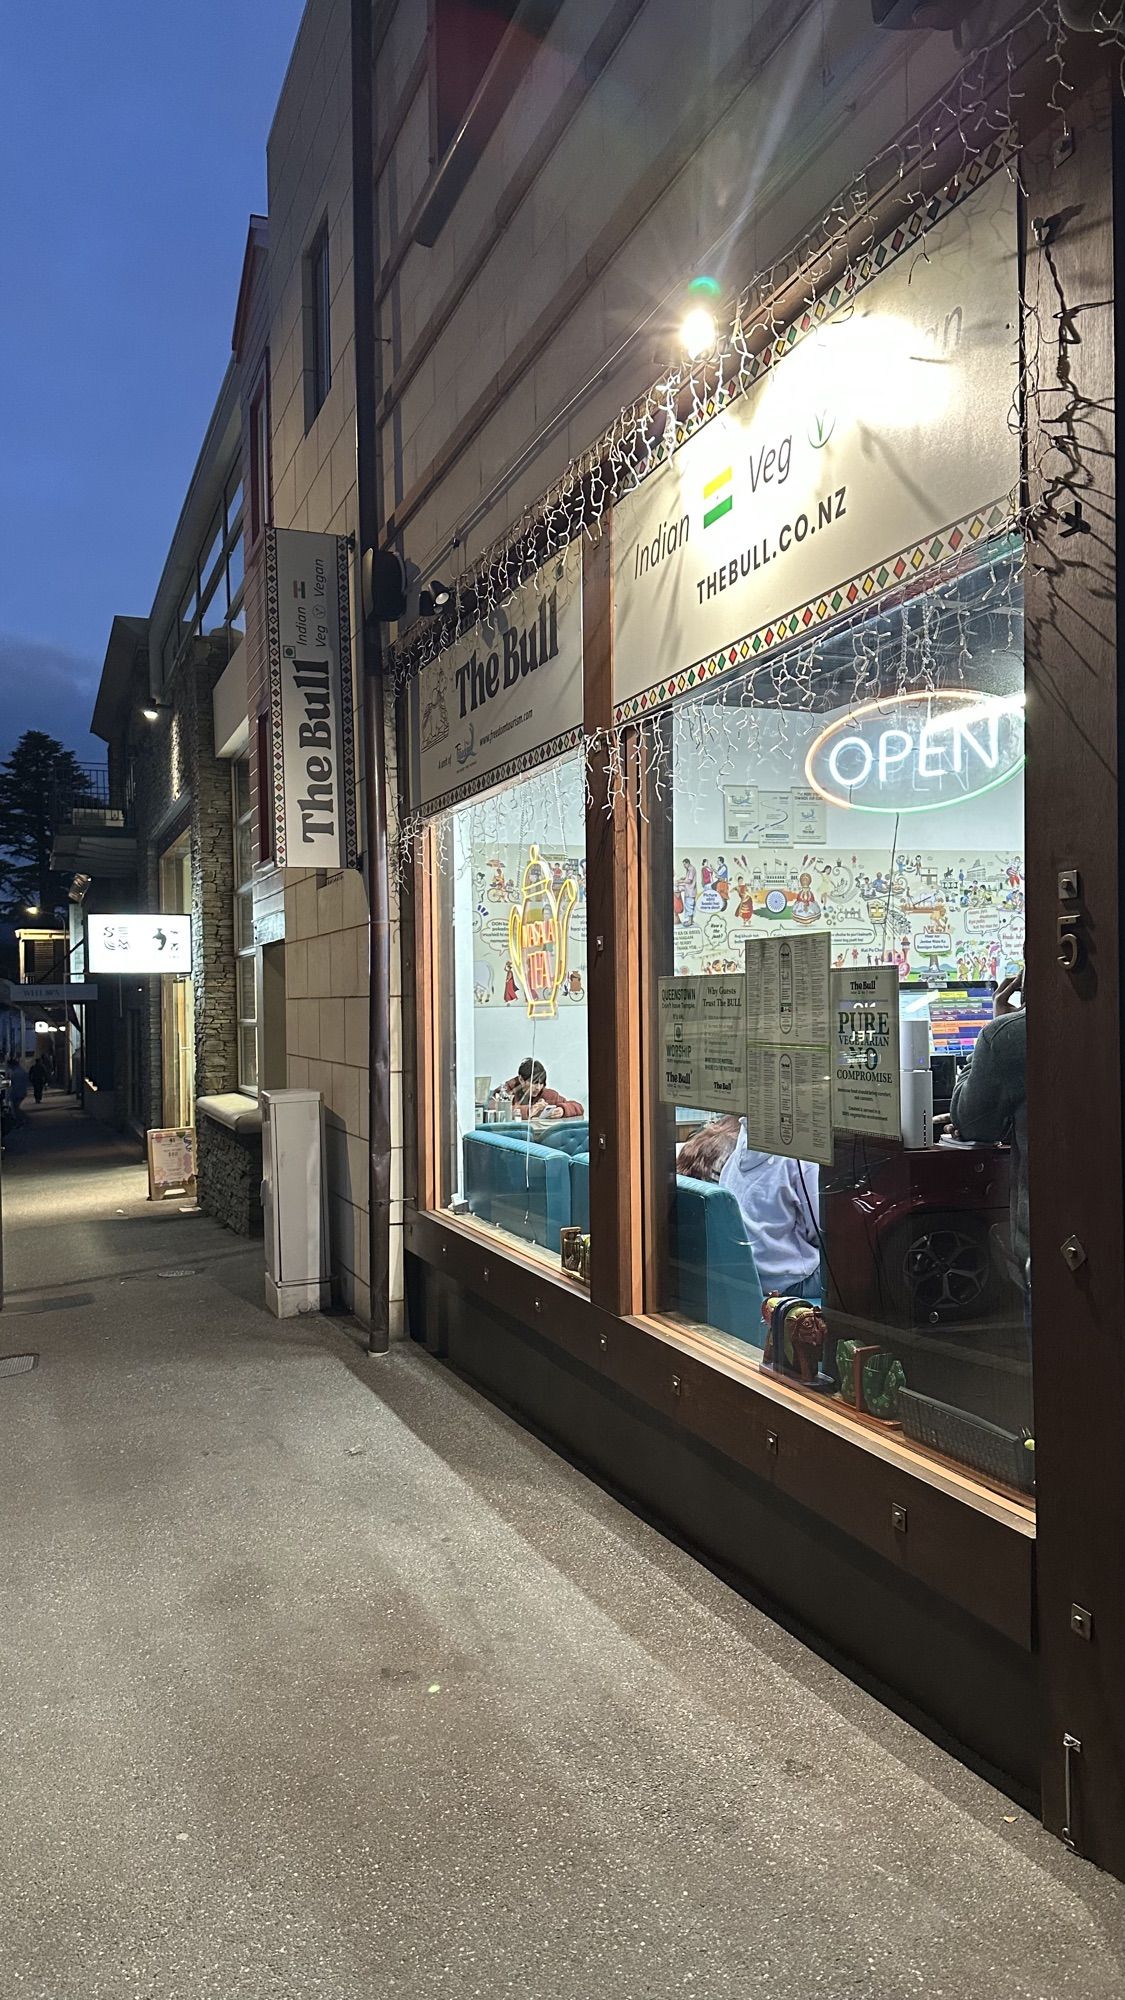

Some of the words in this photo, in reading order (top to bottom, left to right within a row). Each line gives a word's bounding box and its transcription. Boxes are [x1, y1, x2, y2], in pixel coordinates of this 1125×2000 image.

[634, 513, 690, 579] Indian
[749, 434, 792, 493] Veg
[696, 486, 847, 605] THEBULL.CO.NZ
[314, 558, 325, 597] Vegan
[296, 606, 307, 646] Indian
[315, 624, 327, 648] Veg
[456, 649, 499, 719] The
[502, 586, 559, 690] Bull
[292, 660, 331, 750] Bull
[829, 716, 999, 786] OPEN
[297, 755, 334, 844] The
[521, 919, 555, 949] MASALA
[1057, 914, 1080, 970] 5
[527, 951, 552, 989] TEA
[662, 989, 695, 1001] QUEENSTOWN
[708, 987, 717, 997] Why
[719, 986, 736, 995] Guests
[849, 981, 863, 990] The
[863, 979, 876, 990] Bull
[703, 999, 716, 1007] Trust
[717, 999, 726, 1007] The
[727, 998, 742, 1007] BULL
[838, 1012, 890, 1035] PURE
[666, 1044, 692, 1058] WORSHIP
[838, 1034, 889, 1047] VEGETARIAN
[849, 1046, 878, 1071] NO
[666, 1071, 678, 1083] The
[678, 1072, 691, 1084] Bull
[713, 1081, 722, 1089] The
[722, 1082, 732, 1091] Bull
[837, 1070, 892, 1084] COMPROMISE
